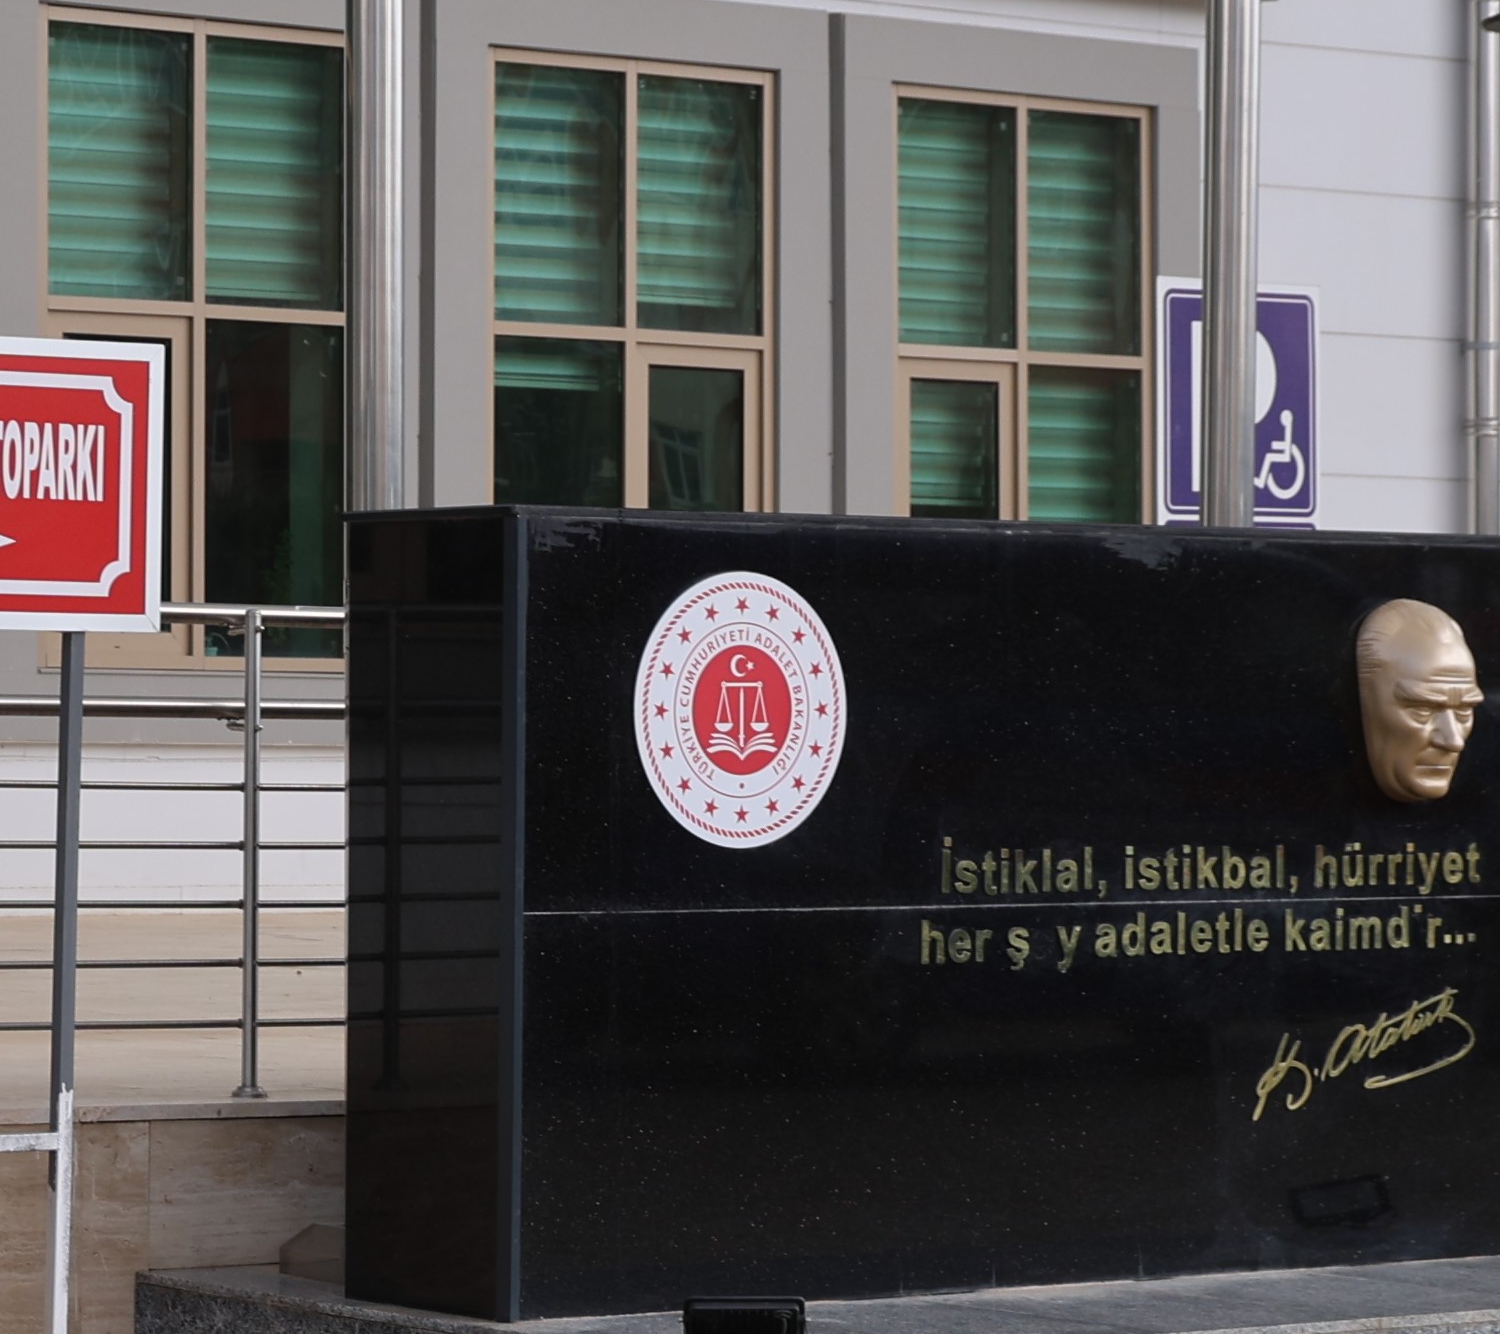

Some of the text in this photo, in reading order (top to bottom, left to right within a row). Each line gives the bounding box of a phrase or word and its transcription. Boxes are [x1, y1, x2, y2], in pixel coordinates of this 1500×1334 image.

[679, 626, 803, 780] TÜRKİYE CUMHURİYETİ ADALET BAKANLIĞI
[940, 836, 1482, 900] İstiklal, istikbal, hürriyet
[919, 918, 992, 967] her
[1095, 907, 1269, 958] adaletle
